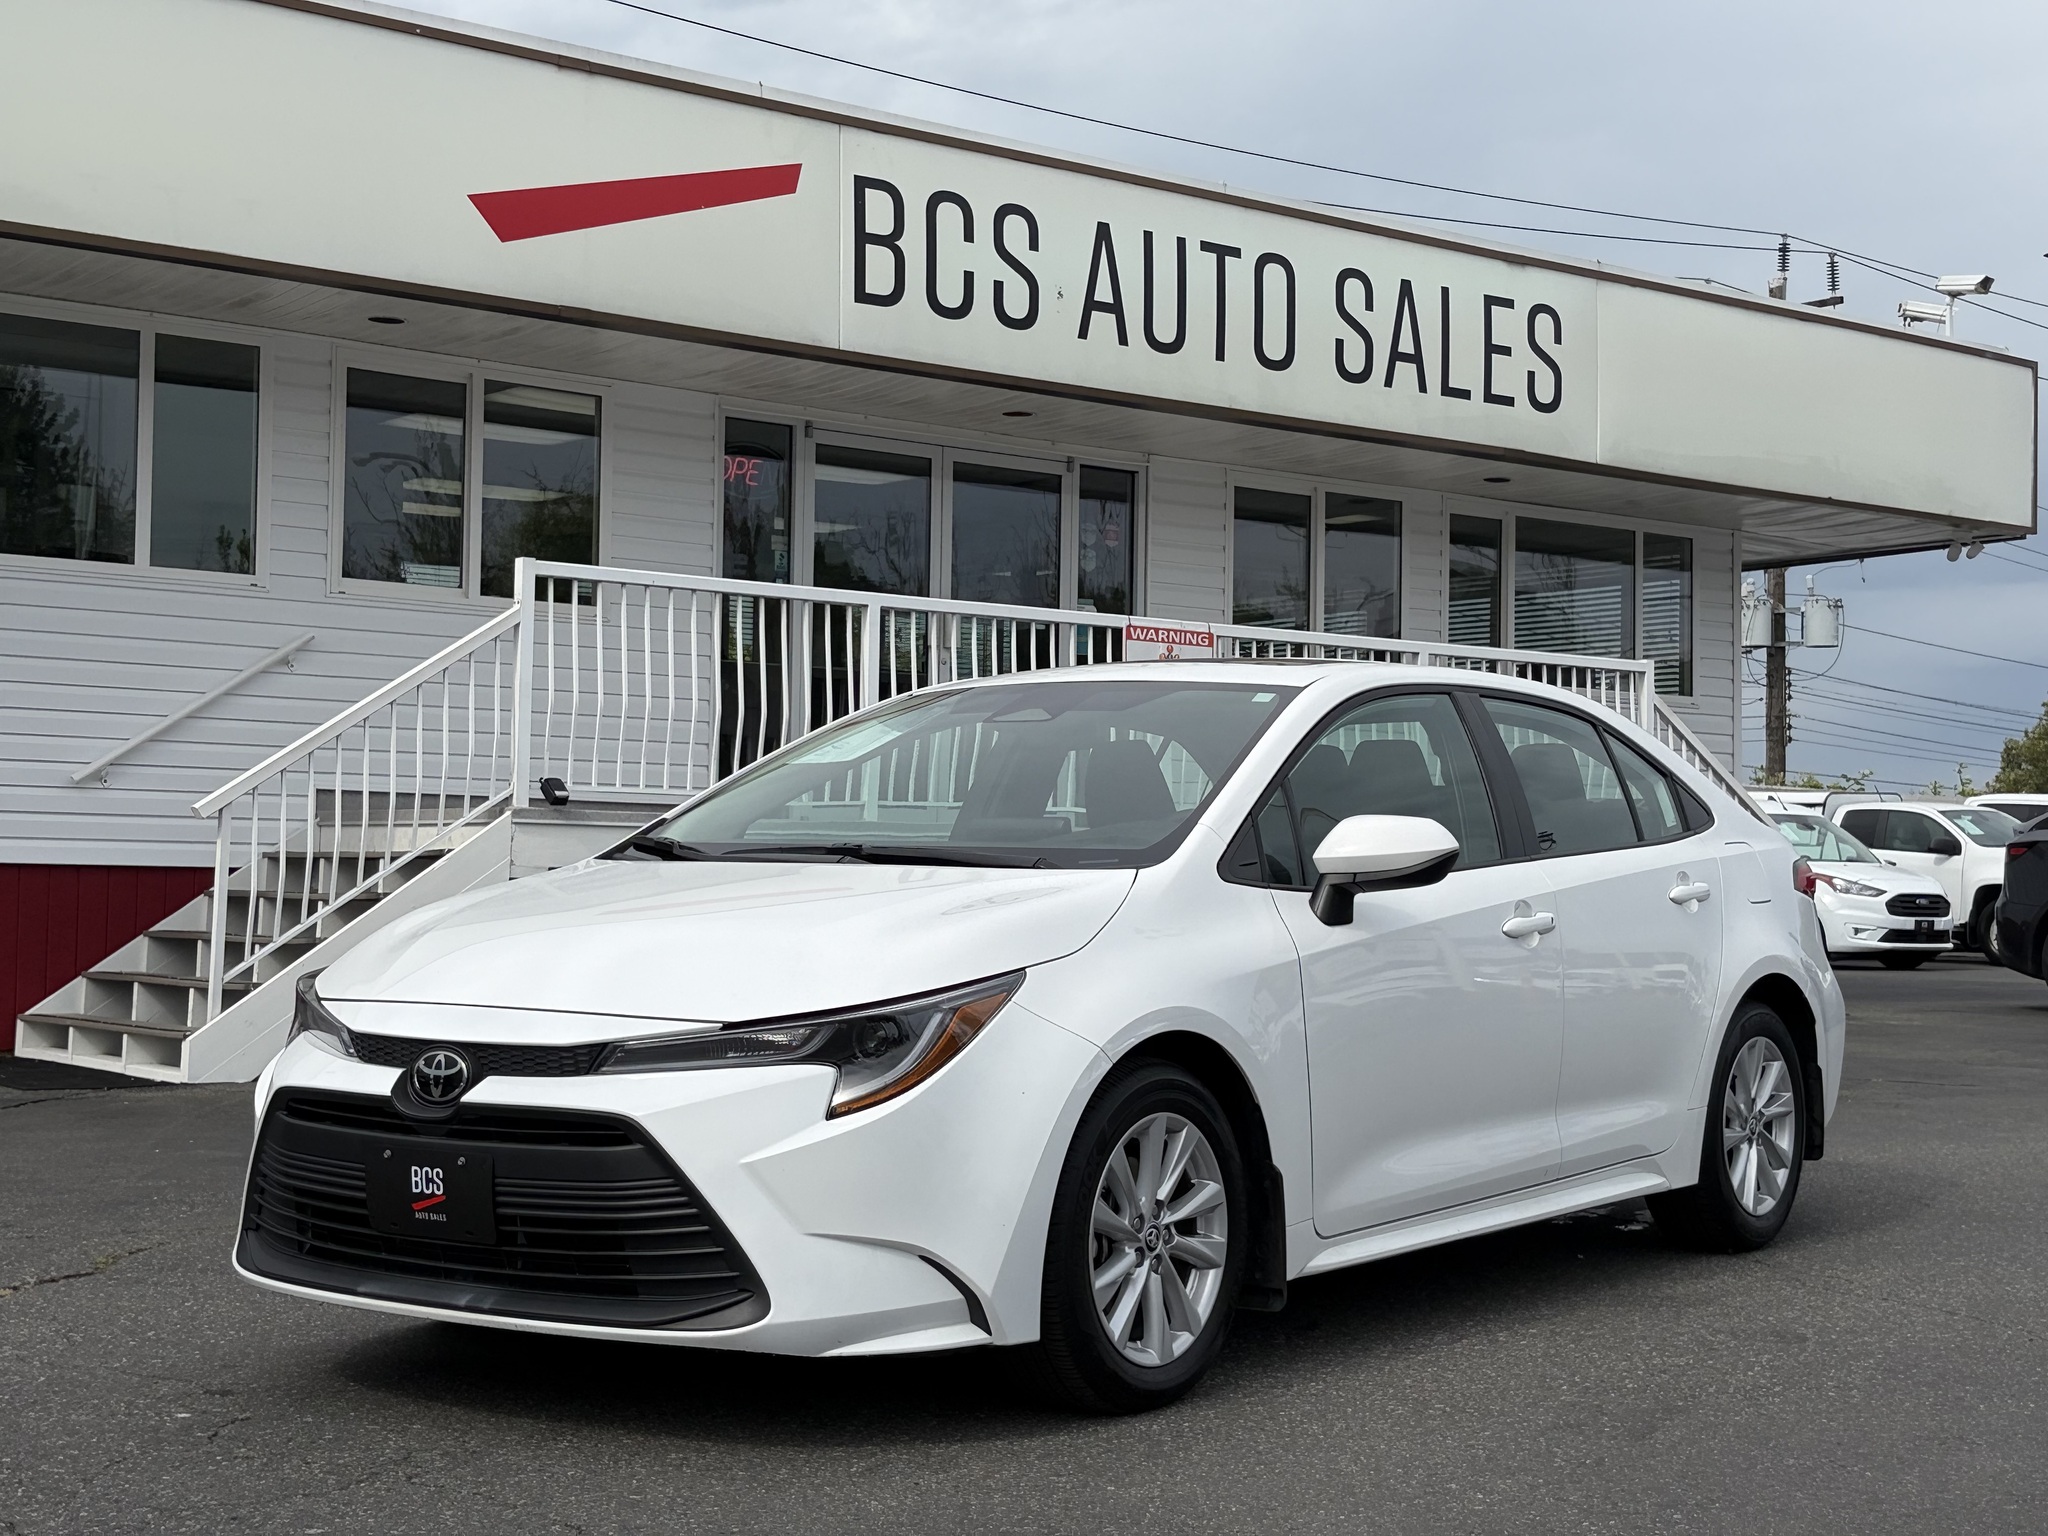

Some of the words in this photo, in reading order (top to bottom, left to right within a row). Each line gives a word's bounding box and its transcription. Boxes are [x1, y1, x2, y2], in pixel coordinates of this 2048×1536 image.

[854, 175, 1039, 330] BCS
[1078, 221, 1296, 371] AUTO
[1335, 267, 1562, 413] SALES
[1130, 627, 1209, 646] WARNING
[412, 1166, 443, 1195] BCS
